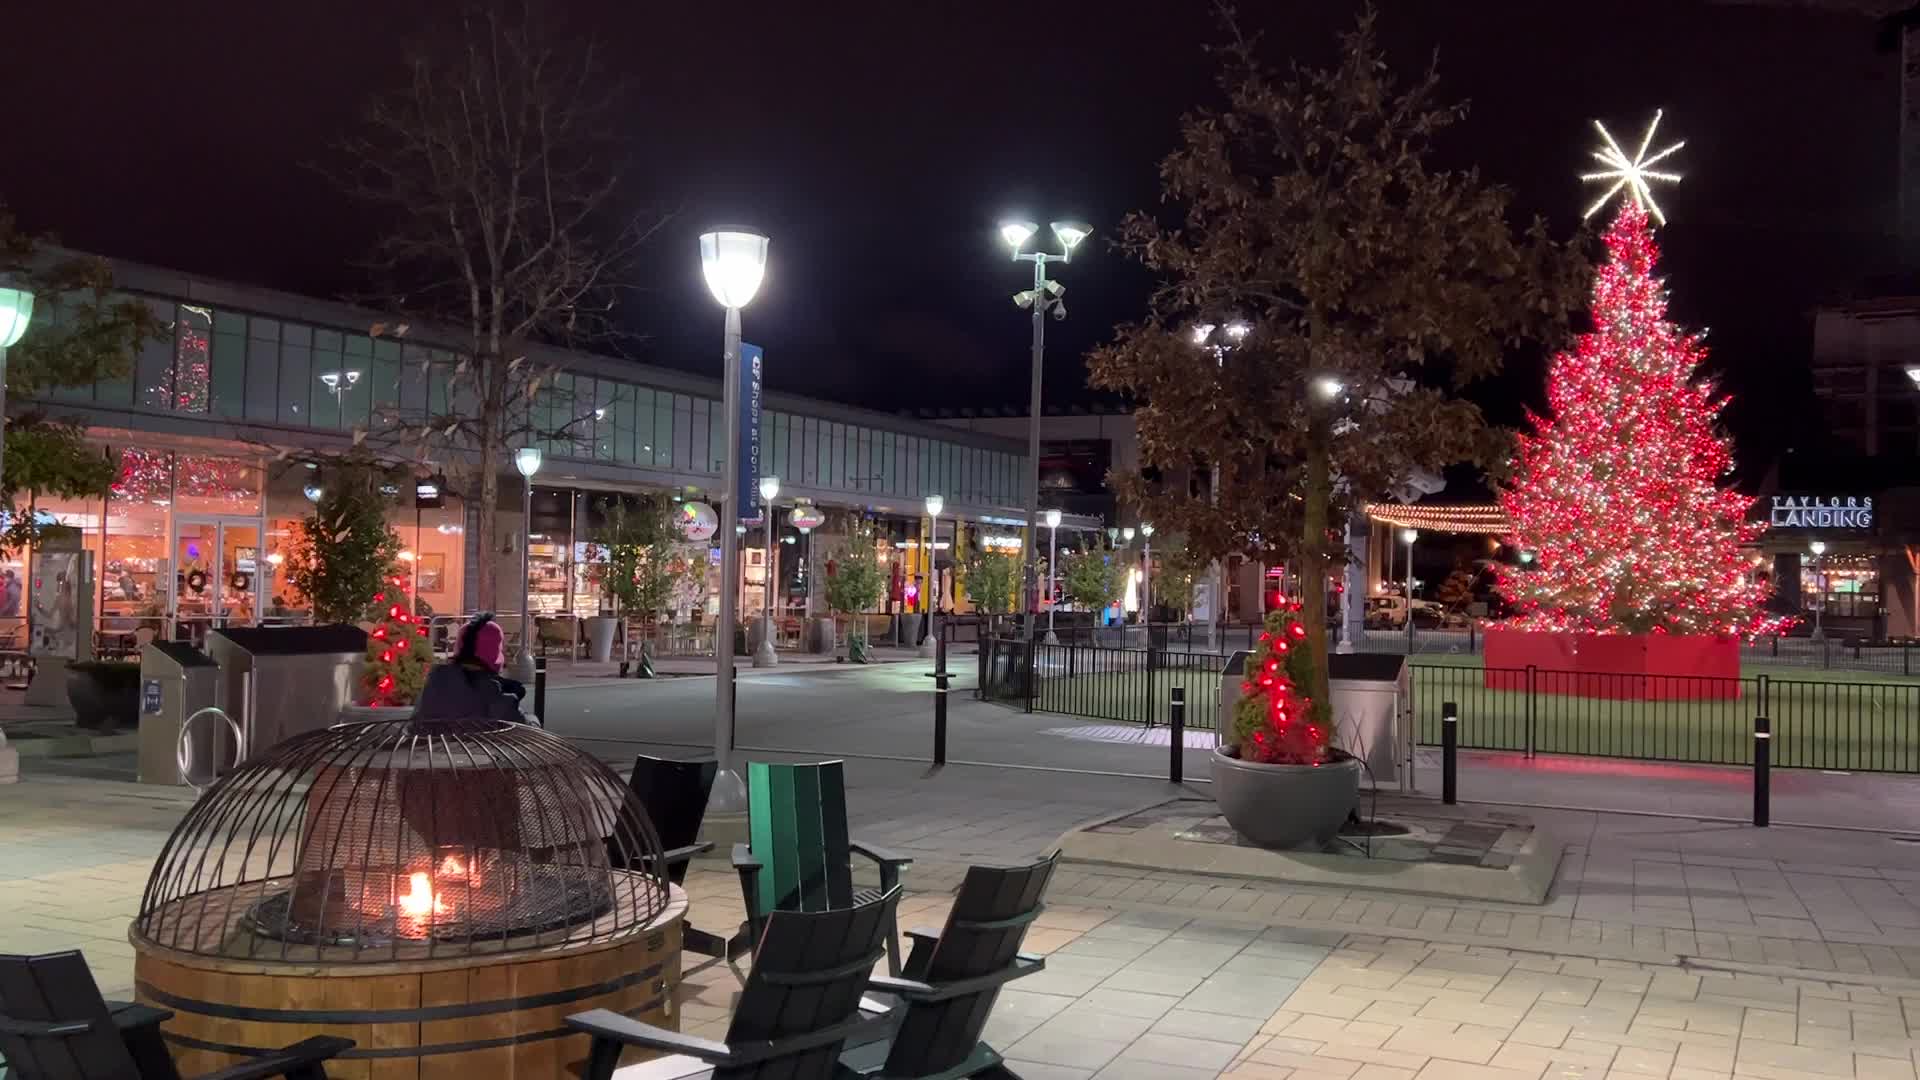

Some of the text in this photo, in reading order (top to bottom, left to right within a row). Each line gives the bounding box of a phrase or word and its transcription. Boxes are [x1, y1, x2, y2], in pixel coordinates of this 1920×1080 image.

[750, 445, 759, 473] Don
[1771, 496, 1872, 508] TAYLORS
[1771, 509, 1872, 528] LANDING
